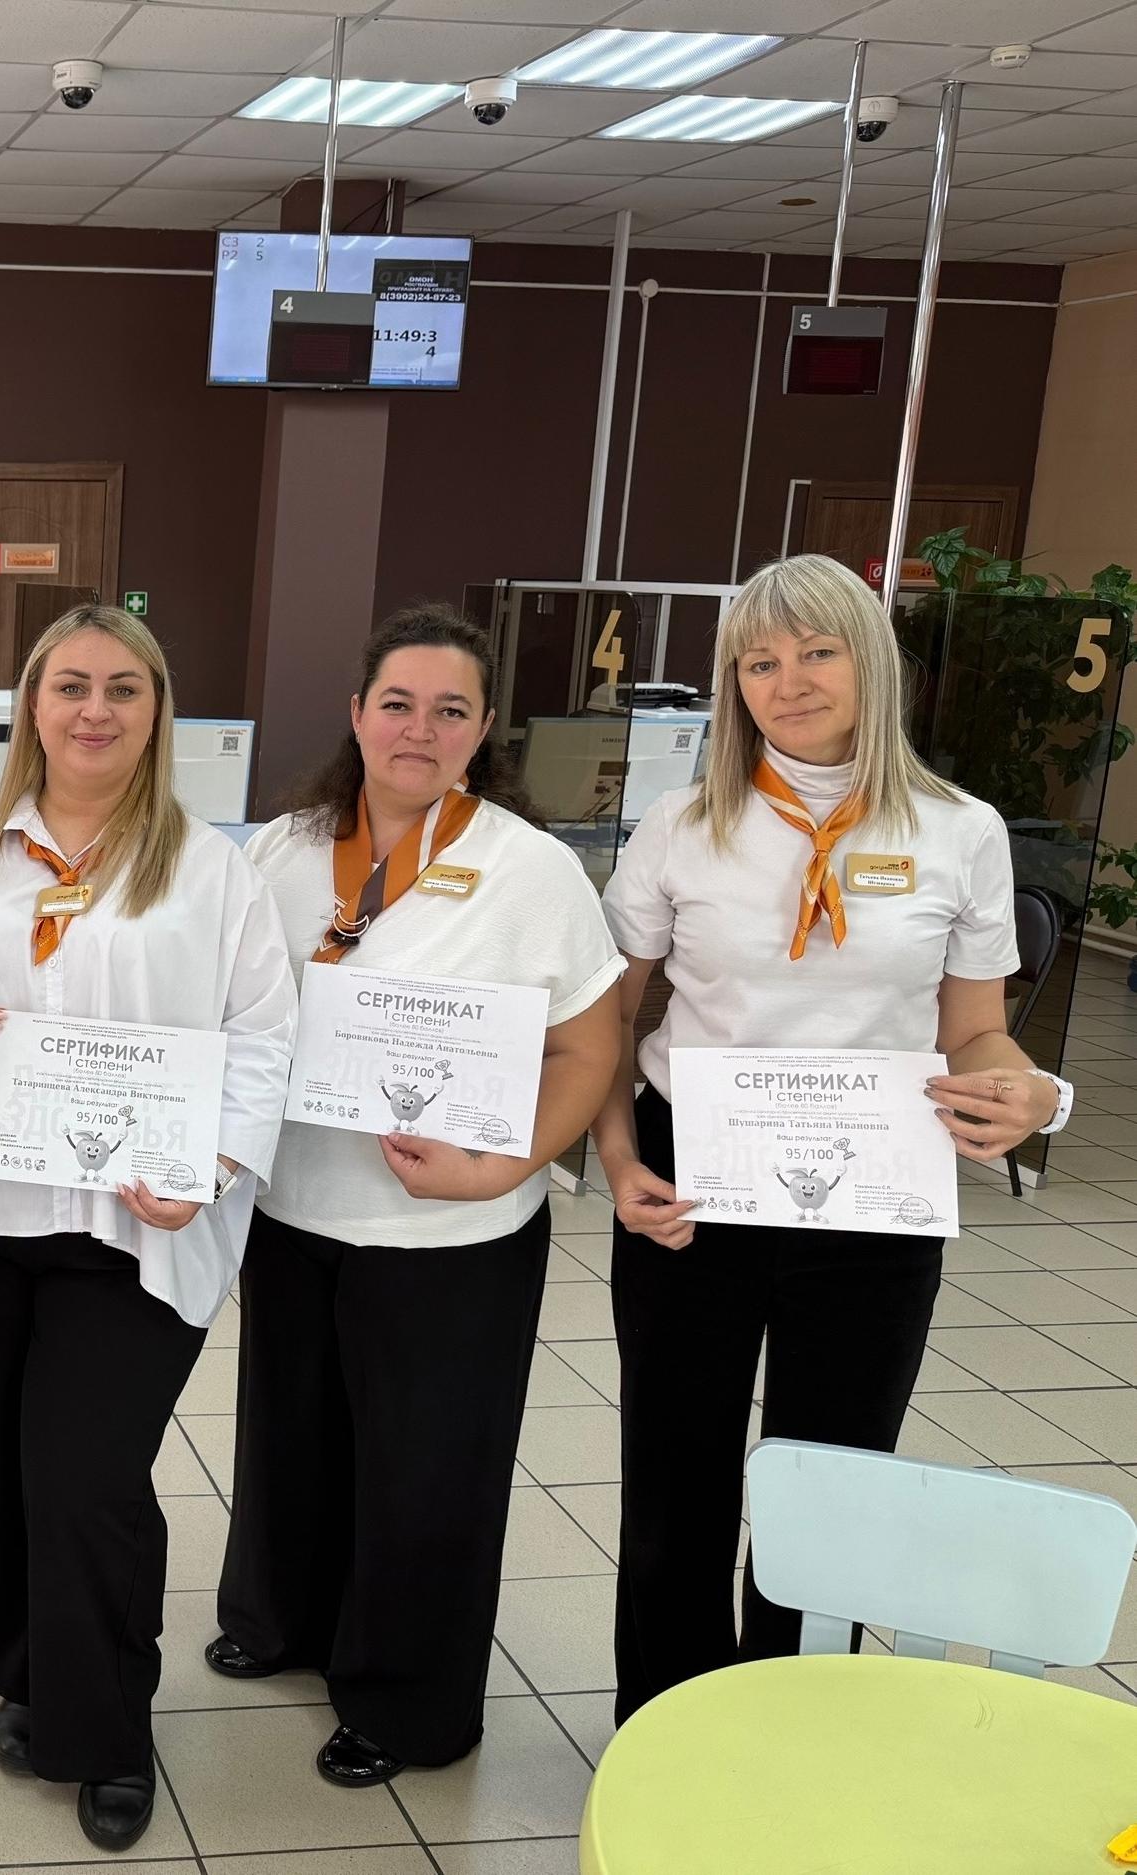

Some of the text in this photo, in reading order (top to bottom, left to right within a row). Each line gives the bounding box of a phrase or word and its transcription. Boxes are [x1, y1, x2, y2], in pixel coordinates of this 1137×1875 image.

[256, 237, 265, 248] 2
[255, 250, 264, 261] 5
[279, 296, 294, 314] 4
[799, 313, 812, 330] 5
[425, 345, 437, 358] 4
[592, 609, 625, 706] 4
[1066, 617, 1113, 693] 5
[356, 991, 485, 1020] СЕРТИФИКАТ
[391, 1013, 451, 1028] степени
[40, 1037, 166, 1064] СЕРТИФИКАТ
[334, 1030, 390, 1045] Боровикова
[392, 1036, 434, 1051] Надежда
[436, 1043, 499, 1059] Анатольевна
[386, 1050, 402, 1058] Ваш
[75, 1058, 133, 1072] степени
[391, 1063, 435, 1079] 95/100
[734, 1072, 879, 1091] СЕРТИФИКАТ
[11, 1078, 71, 1092] Татаринцева
[73, 1084, 128, 1098] Александра
[130, 1089, 186, 1104] Викторовна
[776, 1091, 844, 1103] степени
[70, 1097, 86, 1105] Ваш
[76, 1111, 119, 1125] 95/100
[728, 1118, 890, 1132] Шушарина Татьяна Ивановна
[776, 1133, 795, 1141] Ваш
[785, 1148, 834, 1160] 95/100
